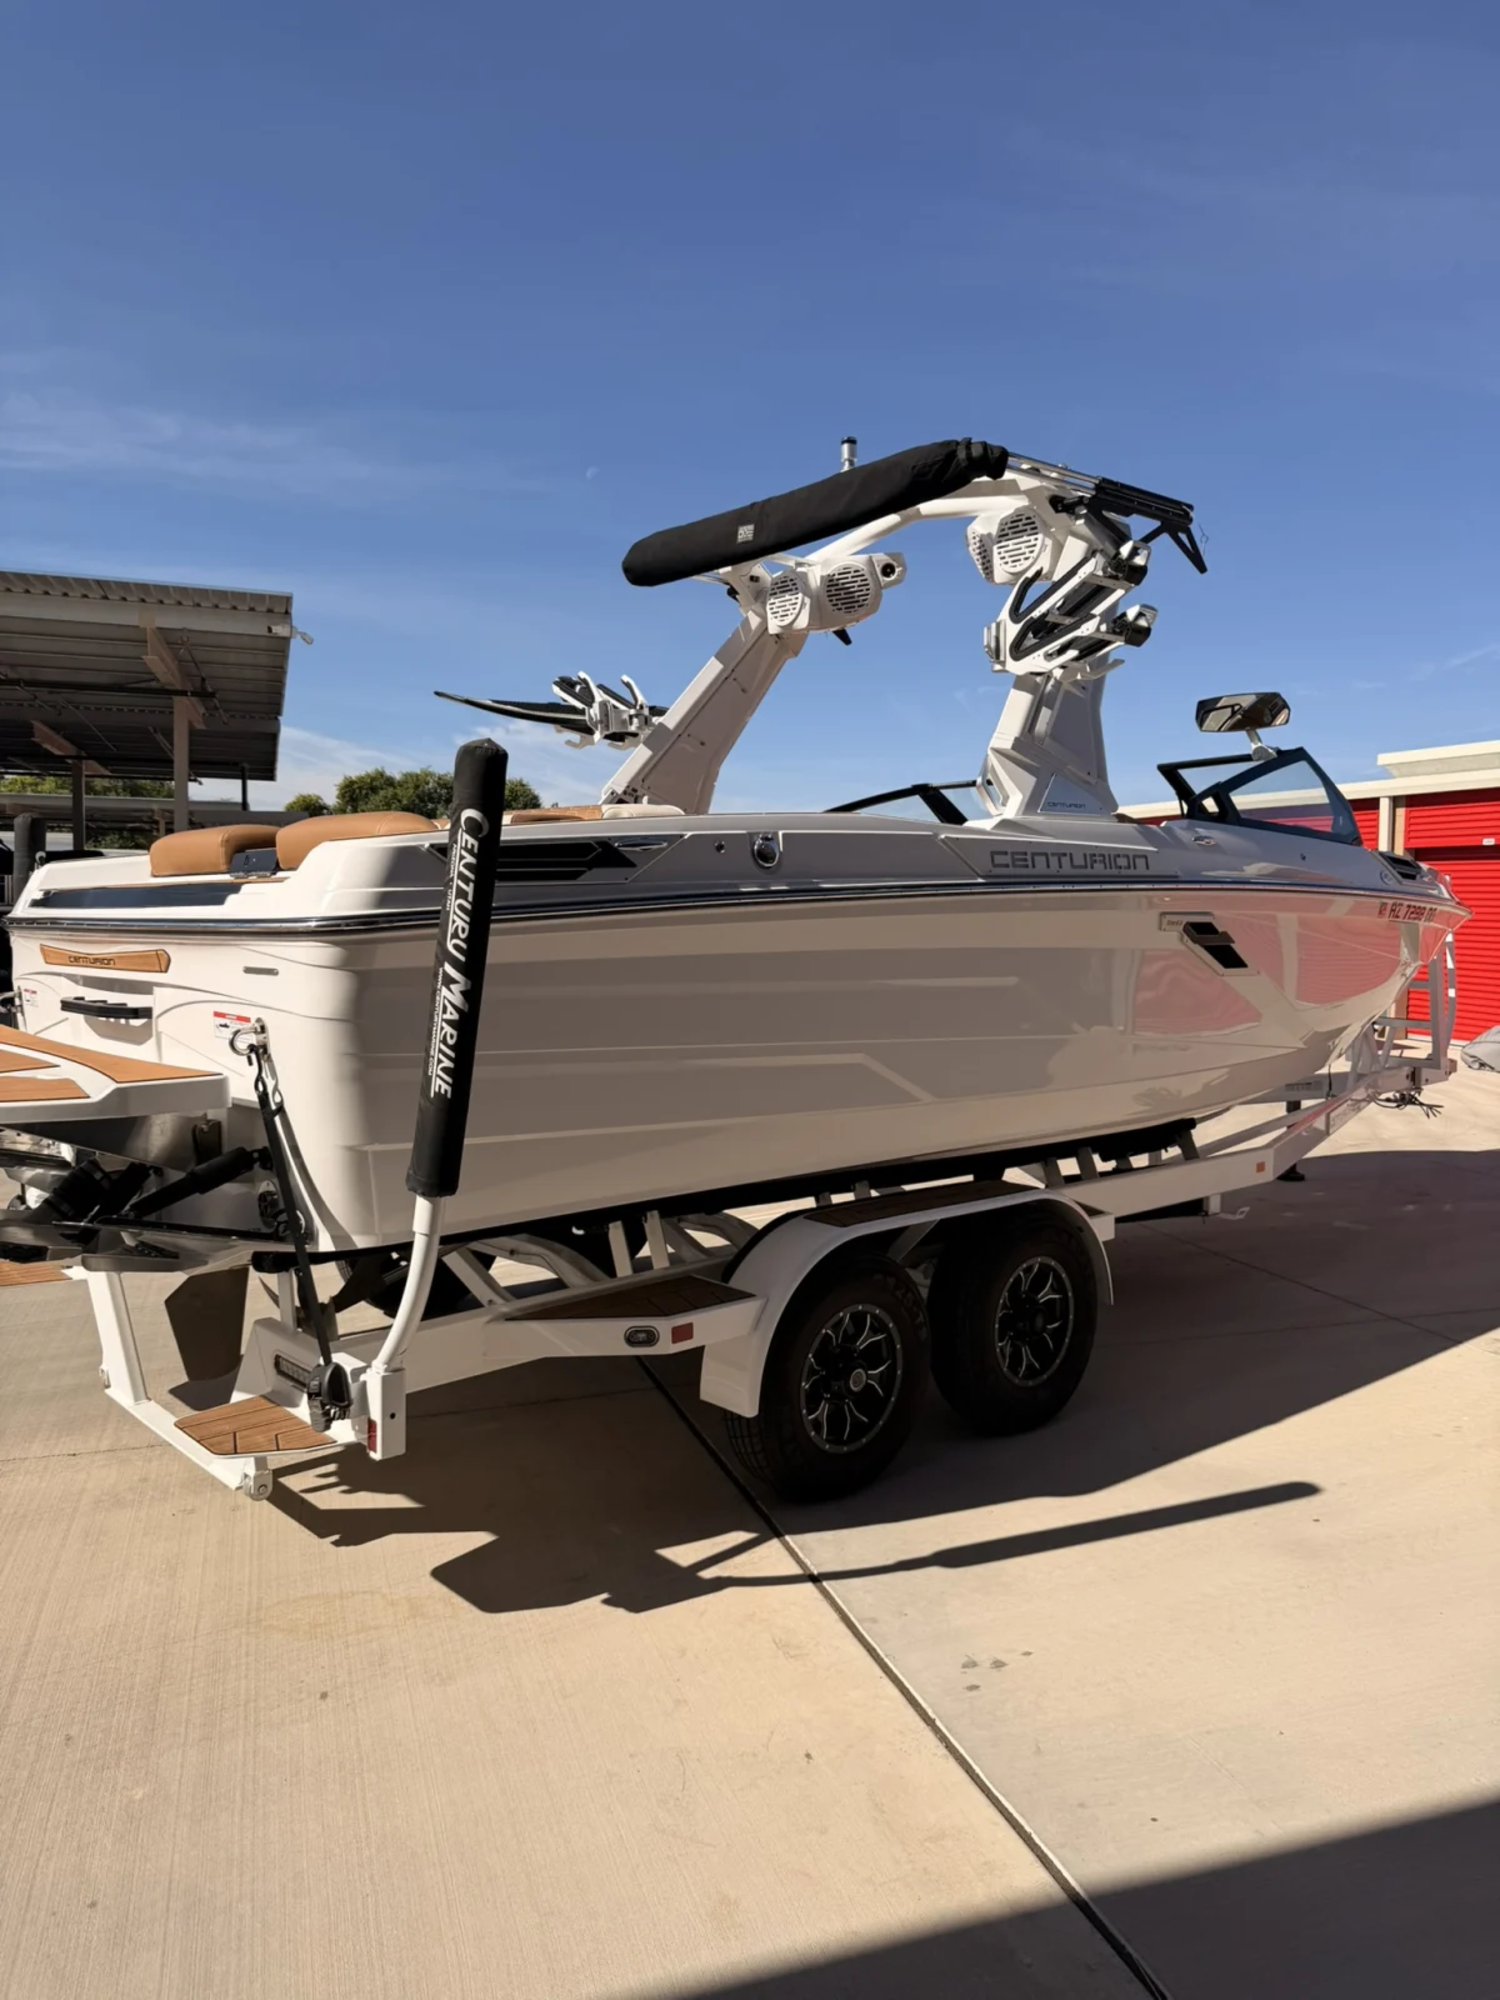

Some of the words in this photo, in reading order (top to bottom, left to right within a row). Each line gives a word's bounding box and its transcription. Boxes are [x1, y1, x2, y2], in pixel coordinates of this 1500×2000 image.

[447, 808, 490, 962] CENTURY
[990, 851, 1149, 871] CENTURION
[432, 961, 472, 1099] MARINE
